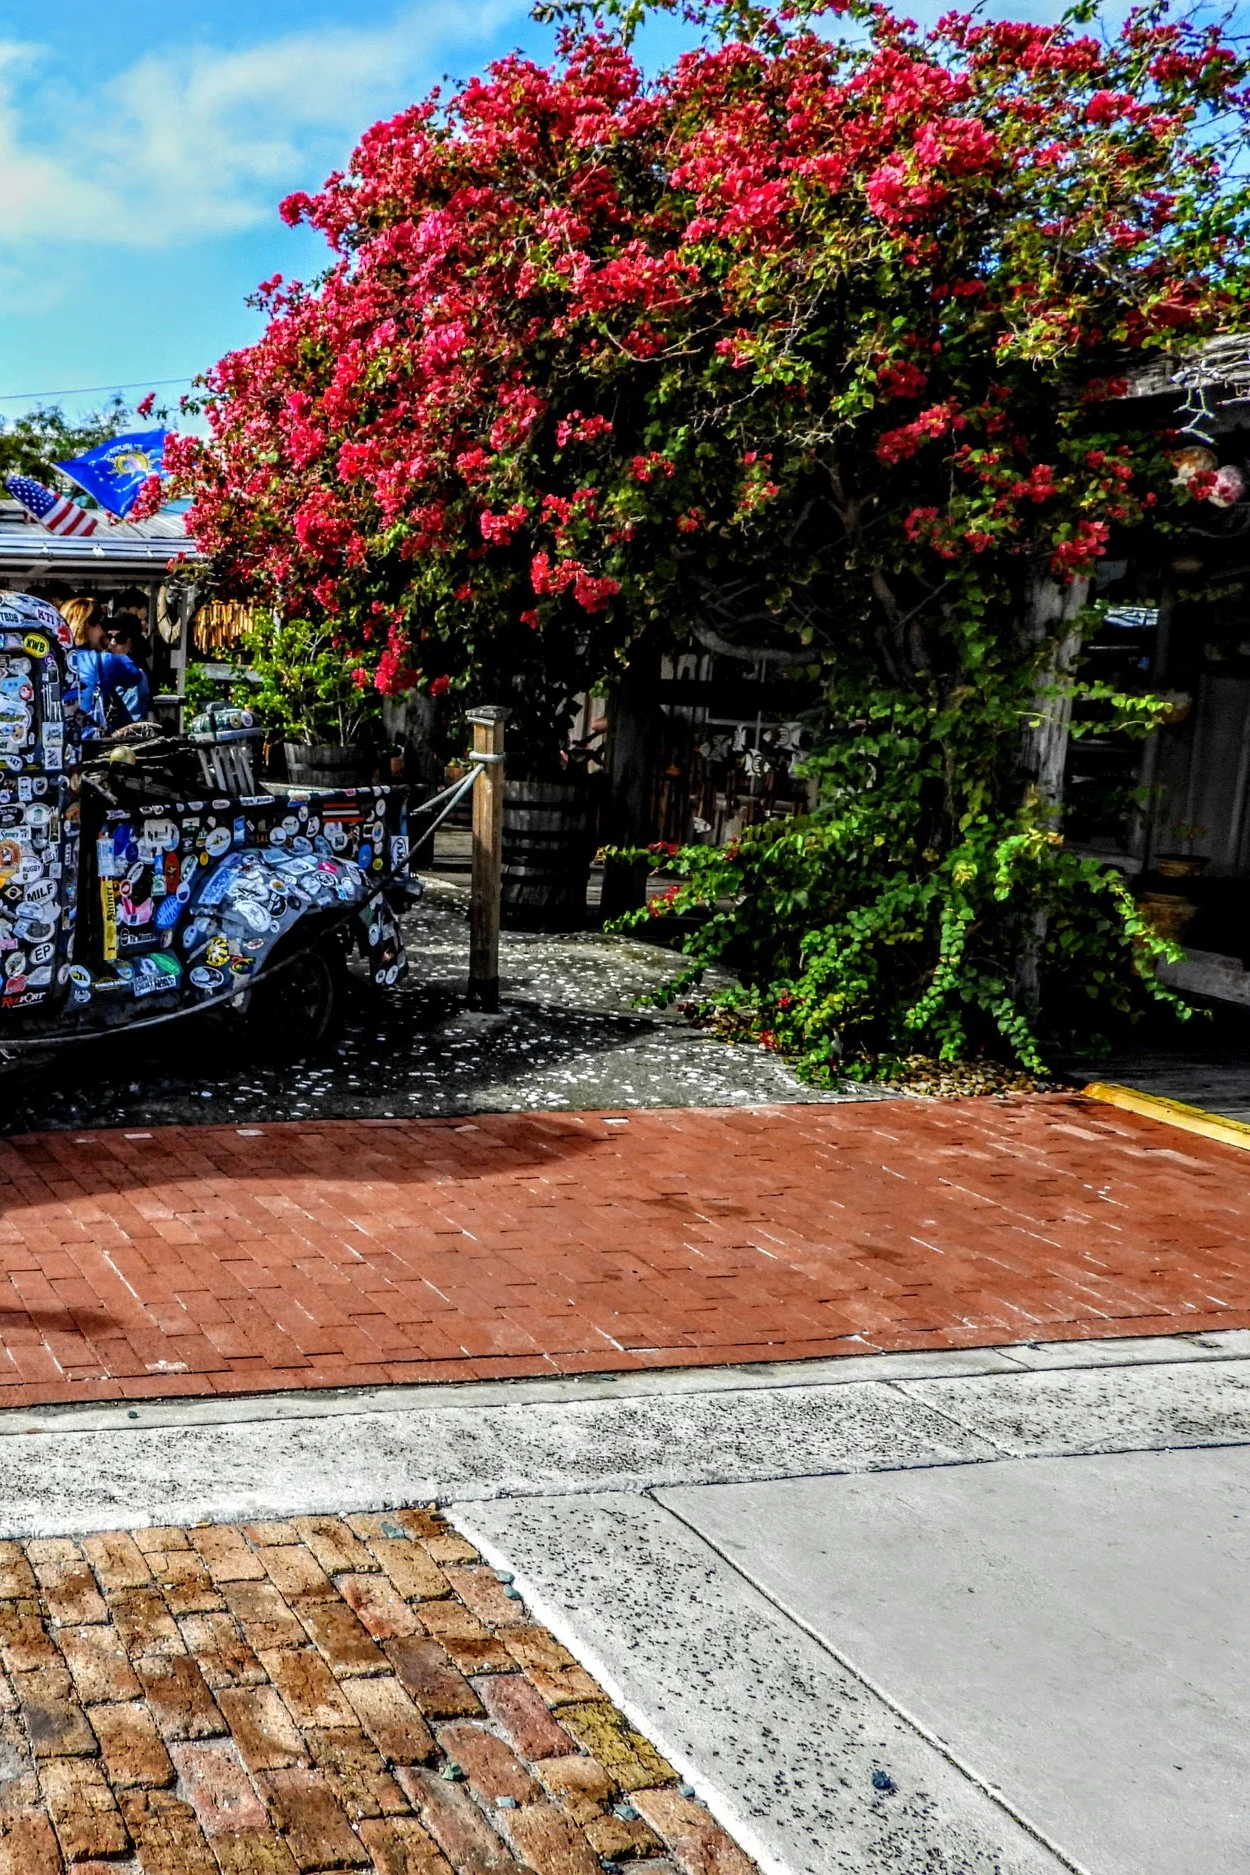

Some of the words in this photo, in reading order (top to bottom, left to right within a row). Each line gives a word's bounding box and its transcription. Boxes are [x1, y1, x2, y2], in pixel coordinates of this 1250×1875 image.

[26, 638, 45, 653] KWB
[22, 865, 41, 873] RUGBY
[26, 883, 54, 903] MILF
[34, 944, 51, 961] EP
